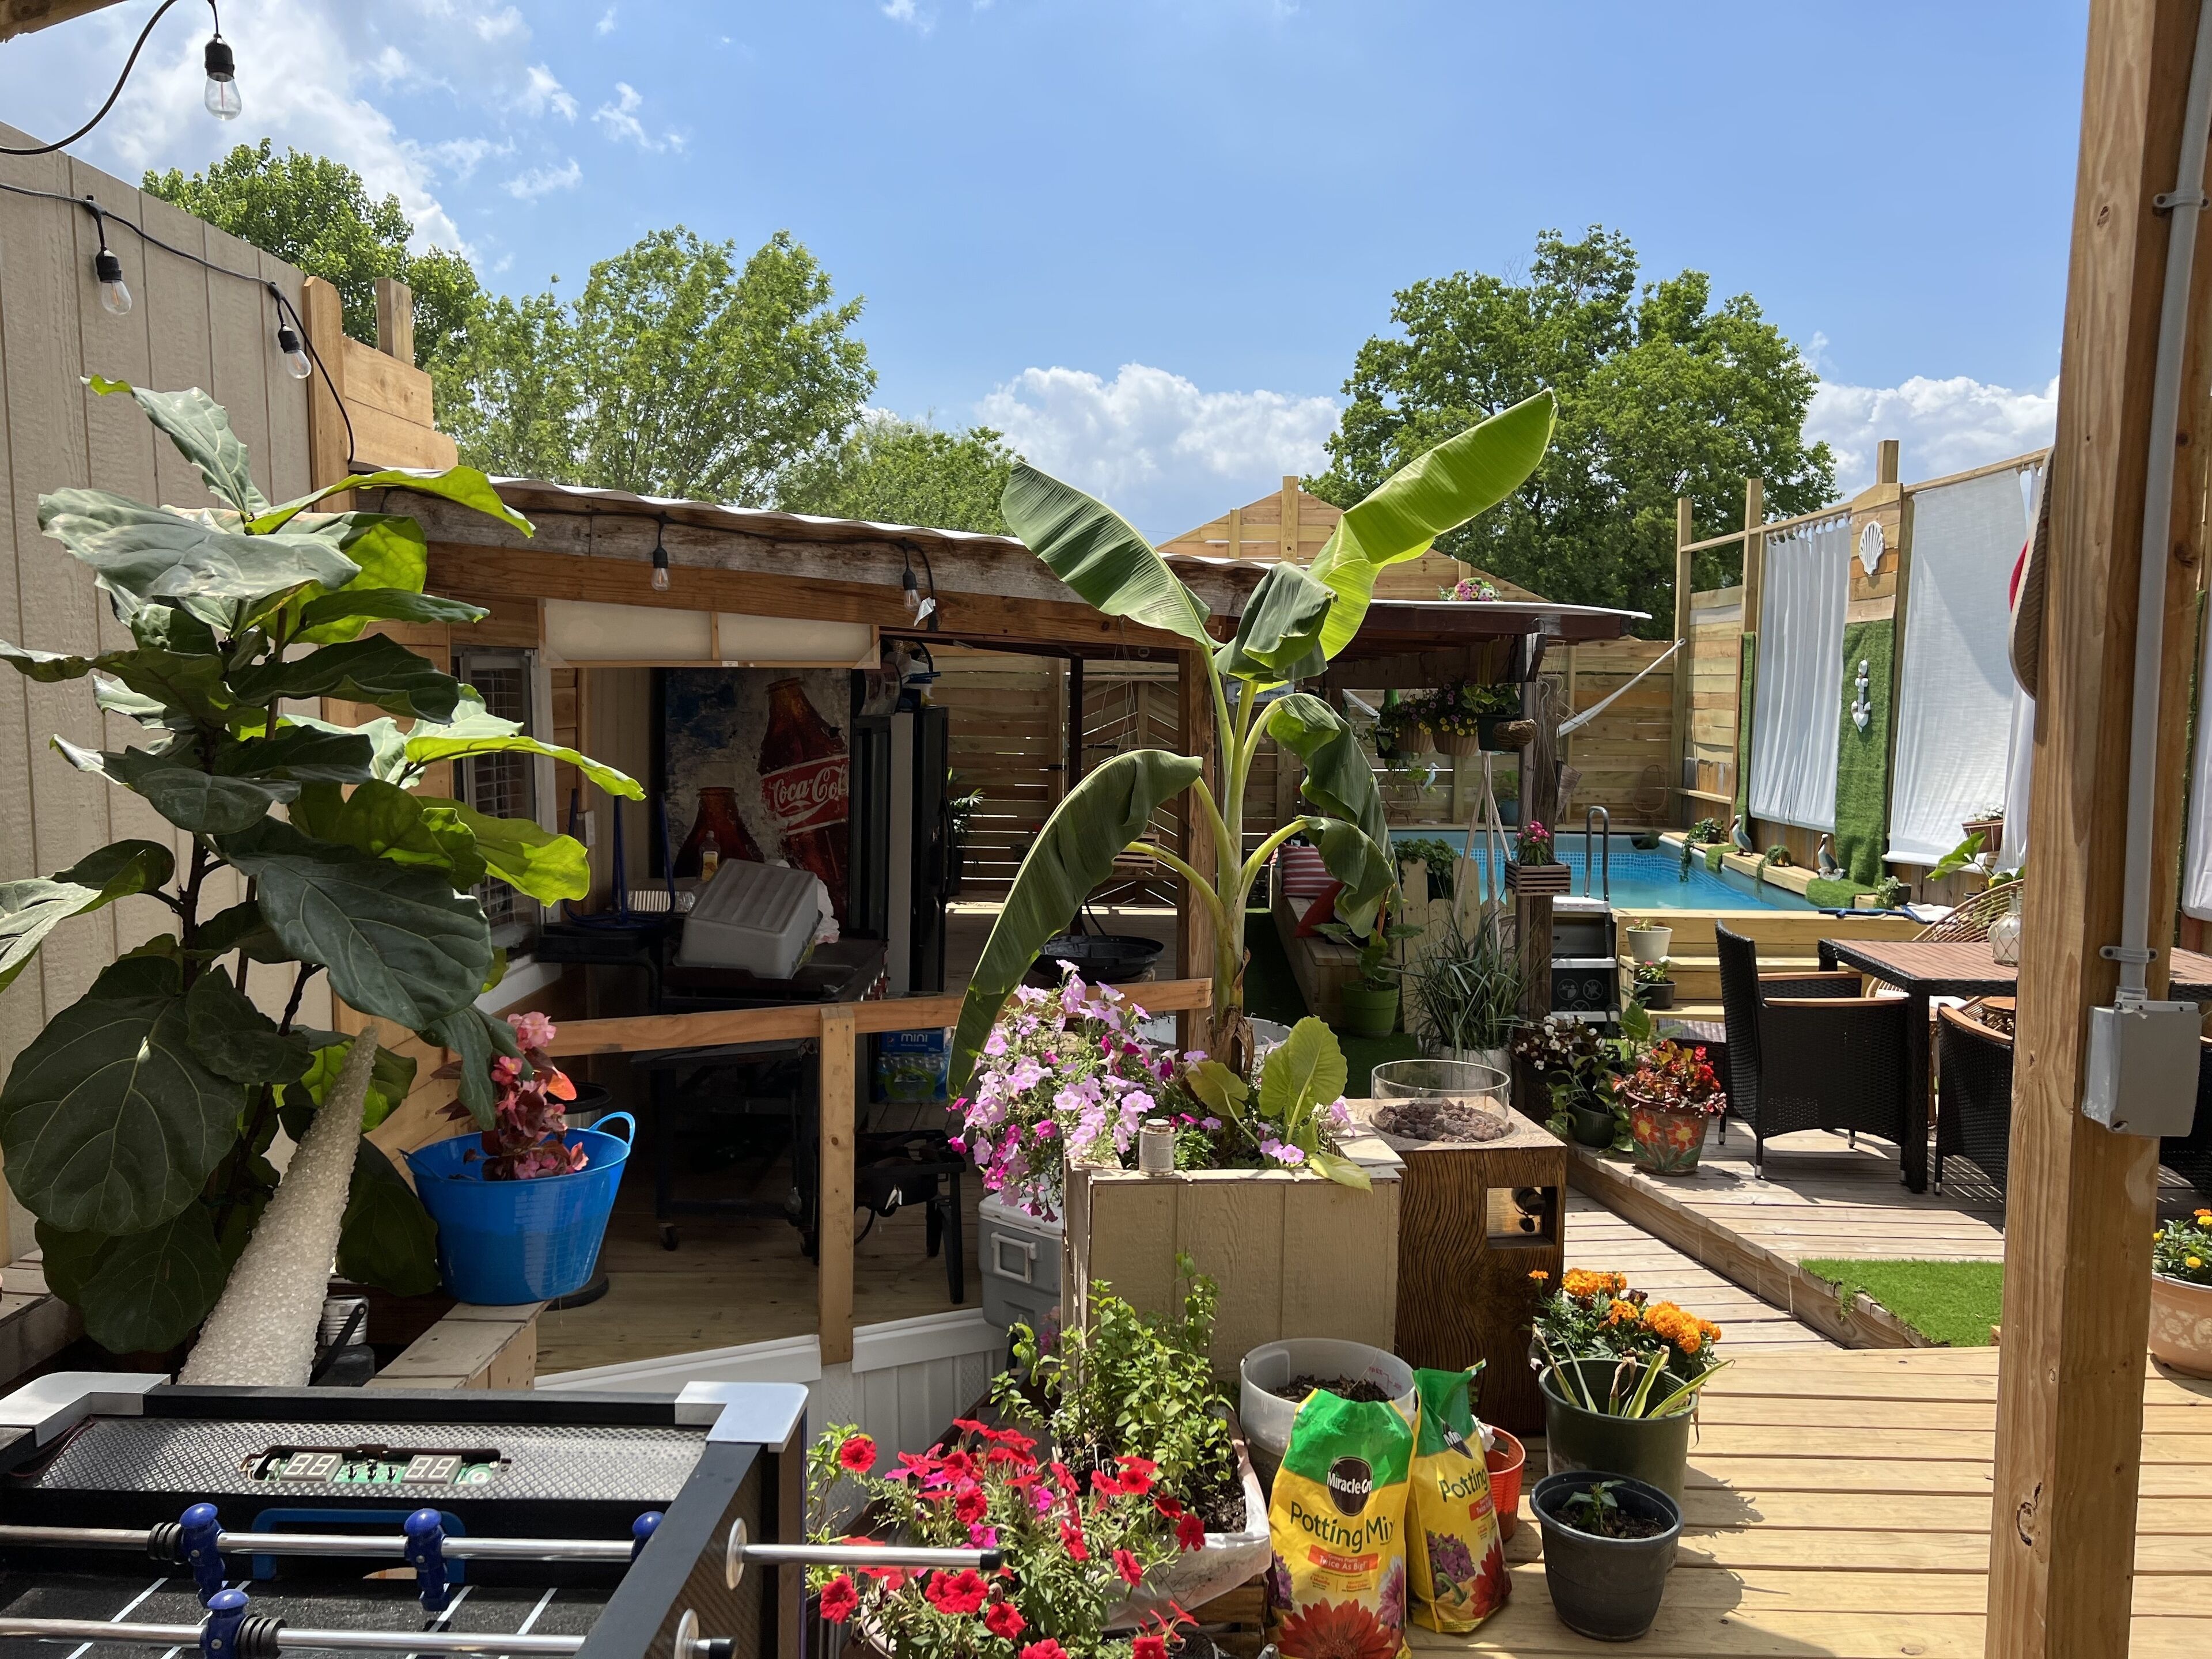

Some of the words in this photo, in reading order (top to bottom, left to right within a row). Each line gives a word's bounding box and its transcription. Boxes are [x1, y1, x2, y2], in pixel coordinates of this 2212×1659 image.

[900, 1033, 928, 1042] mini
[1327, 1471, 1373, 1494] Miracle-Gro
[1438, 1468, 1488, 1503] Potting
[1290, 1501, 1363, 1554] Potting
[1320, 1555, 1340, 1568] Twice
[1342, 1562, 1351, 1570] As
